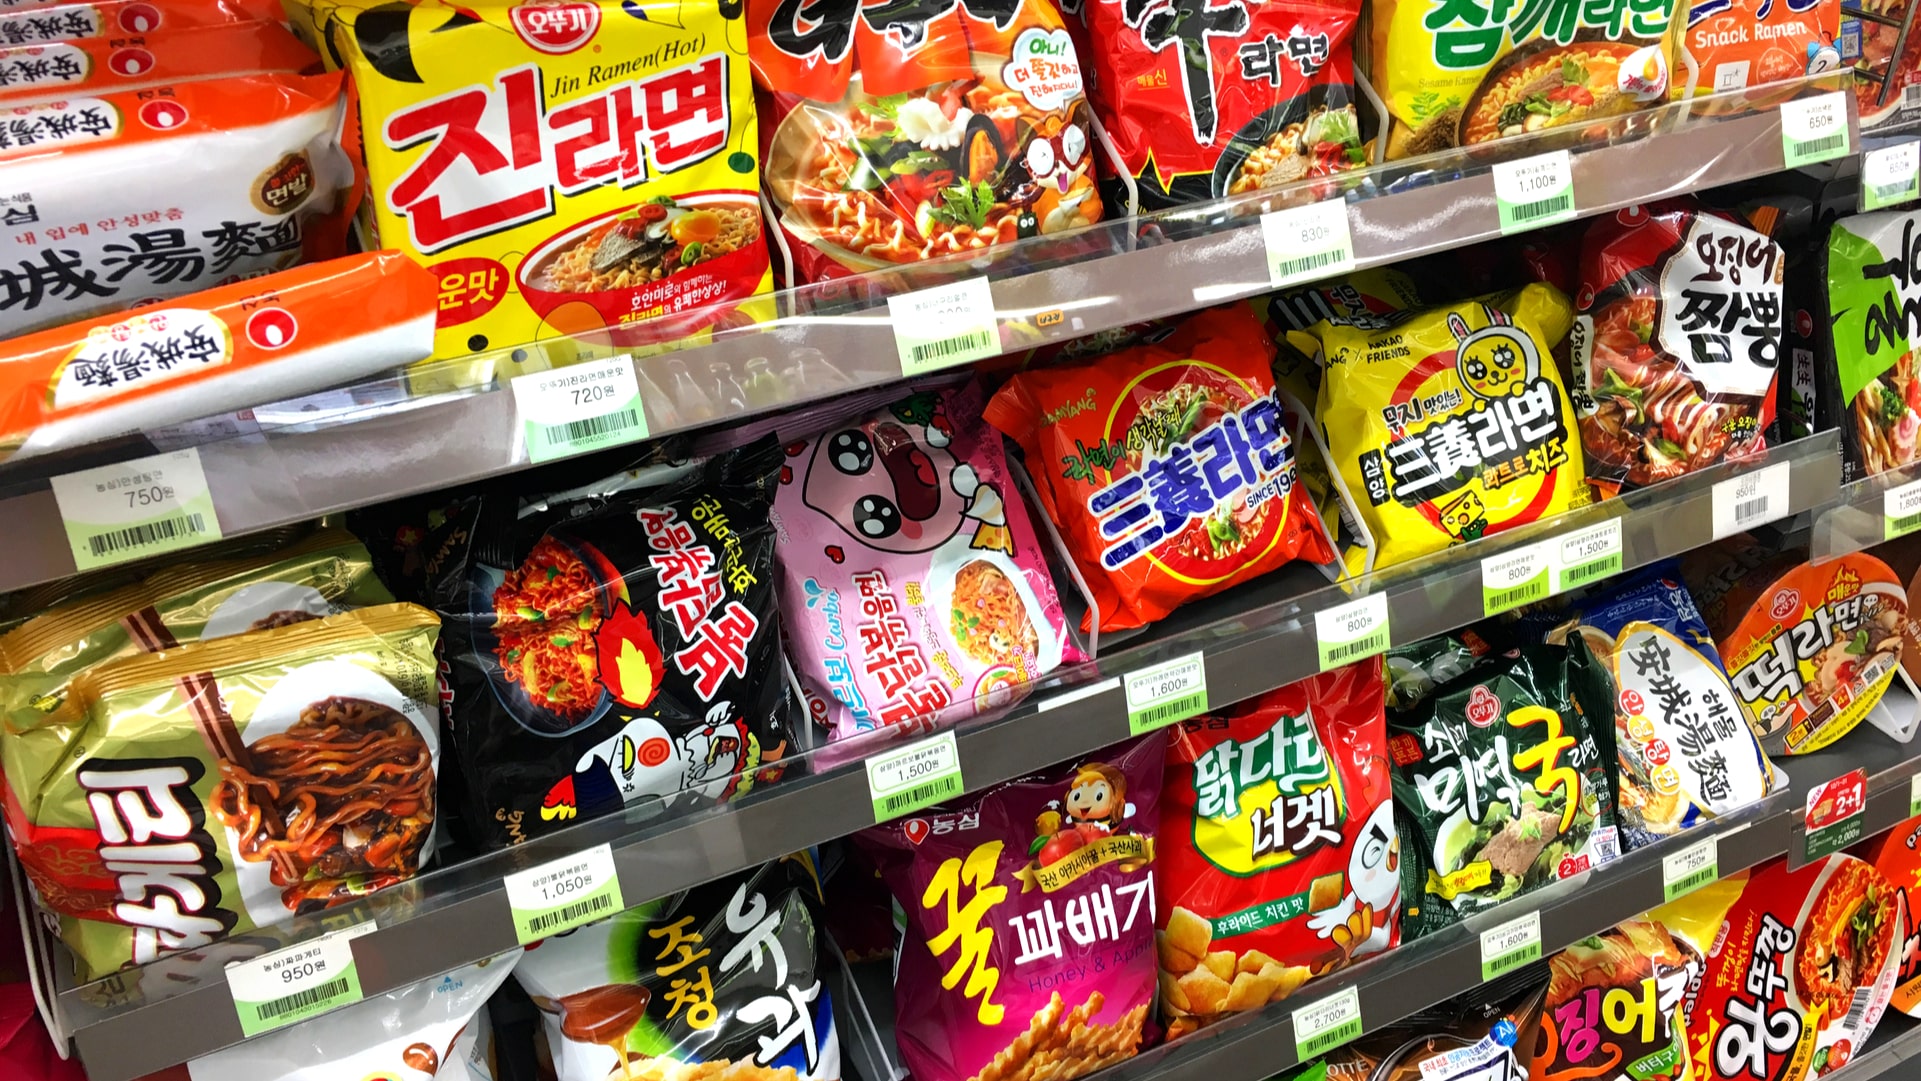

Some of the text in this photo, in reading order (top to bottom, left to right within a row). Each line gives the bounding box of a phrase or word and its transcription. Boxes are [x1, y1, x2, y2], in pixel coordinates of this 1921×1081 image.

[0, 9, 94, 44] 安城湯
[527, 6, 588, 35] 오뚜기
[1695, 21, 1807, 48] Snack Ramen
[1029, 38, 1067, 56] 아니!
[1238, 32, 1330, 87] 라면
[550, 32, 706, 98] Jin Ramen(Hot)
[1014, 67, 1031, 83] 더
[1418, 78, 1454, 89] Sesame
[1809, 115, 1833, 129] 650원
[387, 54, 730, 248] 진라면
[265, 173, 309, 206] 면발
[1519, 174, 1557, 193] 1,100원
[15, 207, 185, 245] 내 입에 안성맞춤
[1690, 231, 1777, 285] 오징어
[437, 268, 501, 309] 운맛
[1367, 335, 1403, 350] KAKAO
[1675, 287, 1781, 369] 짬뽕
[1366, 345, 1411, 365] FRIENDS
[570, 384, 616, 405] 720원
[1382, 388, 1463, 433] 무지 맛있는!
[1364, 455, 1388, 500] 삼양
[123, 485, 175, 508] 750원
[1247, 482, 1274, 508] SINCE
[1579, 539, 1609, 558] 1,500원
[1508, 565, 1532, 581] 800원
[637, 506, 760, 701] 불닭볶음면
[1775, 597, 1799, 616] 오뚜기
[822, 589, 846, 651] Carbo
[851, 569, 953, 737] 불닭볶음면
[1731, 594, 1863, 703] 떡라면
[1150, 677, 1188, 698] 1,600원
[1472, 702, 1495, 717] 오뚜기
[1702, 689, 1738, 739] 해물
[1567, 734, 1599, 769] 라면
[1621, 690, 1678, 792] 안성탕면
[898, 759, 939, 781] 1,500원
[1809, 787, 1822, 807] NEW
[1836, 782, 1862, 816] 2+1
[932, 812, 980, 835] 농심
[1251, 784, 1342, 858] 너겟
[1040, 870, 1060, 889] 국산
[1059, 848, 1100, 879] 아카시아꿀
[1108, 839, 1142, 855] 국산사과
[1686, 855, 1706, 870] 750원
[541, 874, 593, 901] 1,050원
[1216, 896, 1304, 935] 후라이드 치킨 맛
[921, 839, 1156, 1026] 꿀 꽈배기
[1499, 930, 1528, 949] 1,600원
[263, 946, 322, 974] 농심)짜파게티
[281, 959, 327, 984] 950원
[648, 915, 718, 1031] 조청
[1028, 961, 1087, 994] Honey
[1093, 955, 1106, 972] &
[436, 979, 464, 993] OPEN
[719, 880, 822, 1077] 유과
[1716, 912, 1797, 1078] 왕뚜껑
[1314, 1007, 1346, 1029] 2,700원
[1482, 1007, 1501, 1019] OPEN
